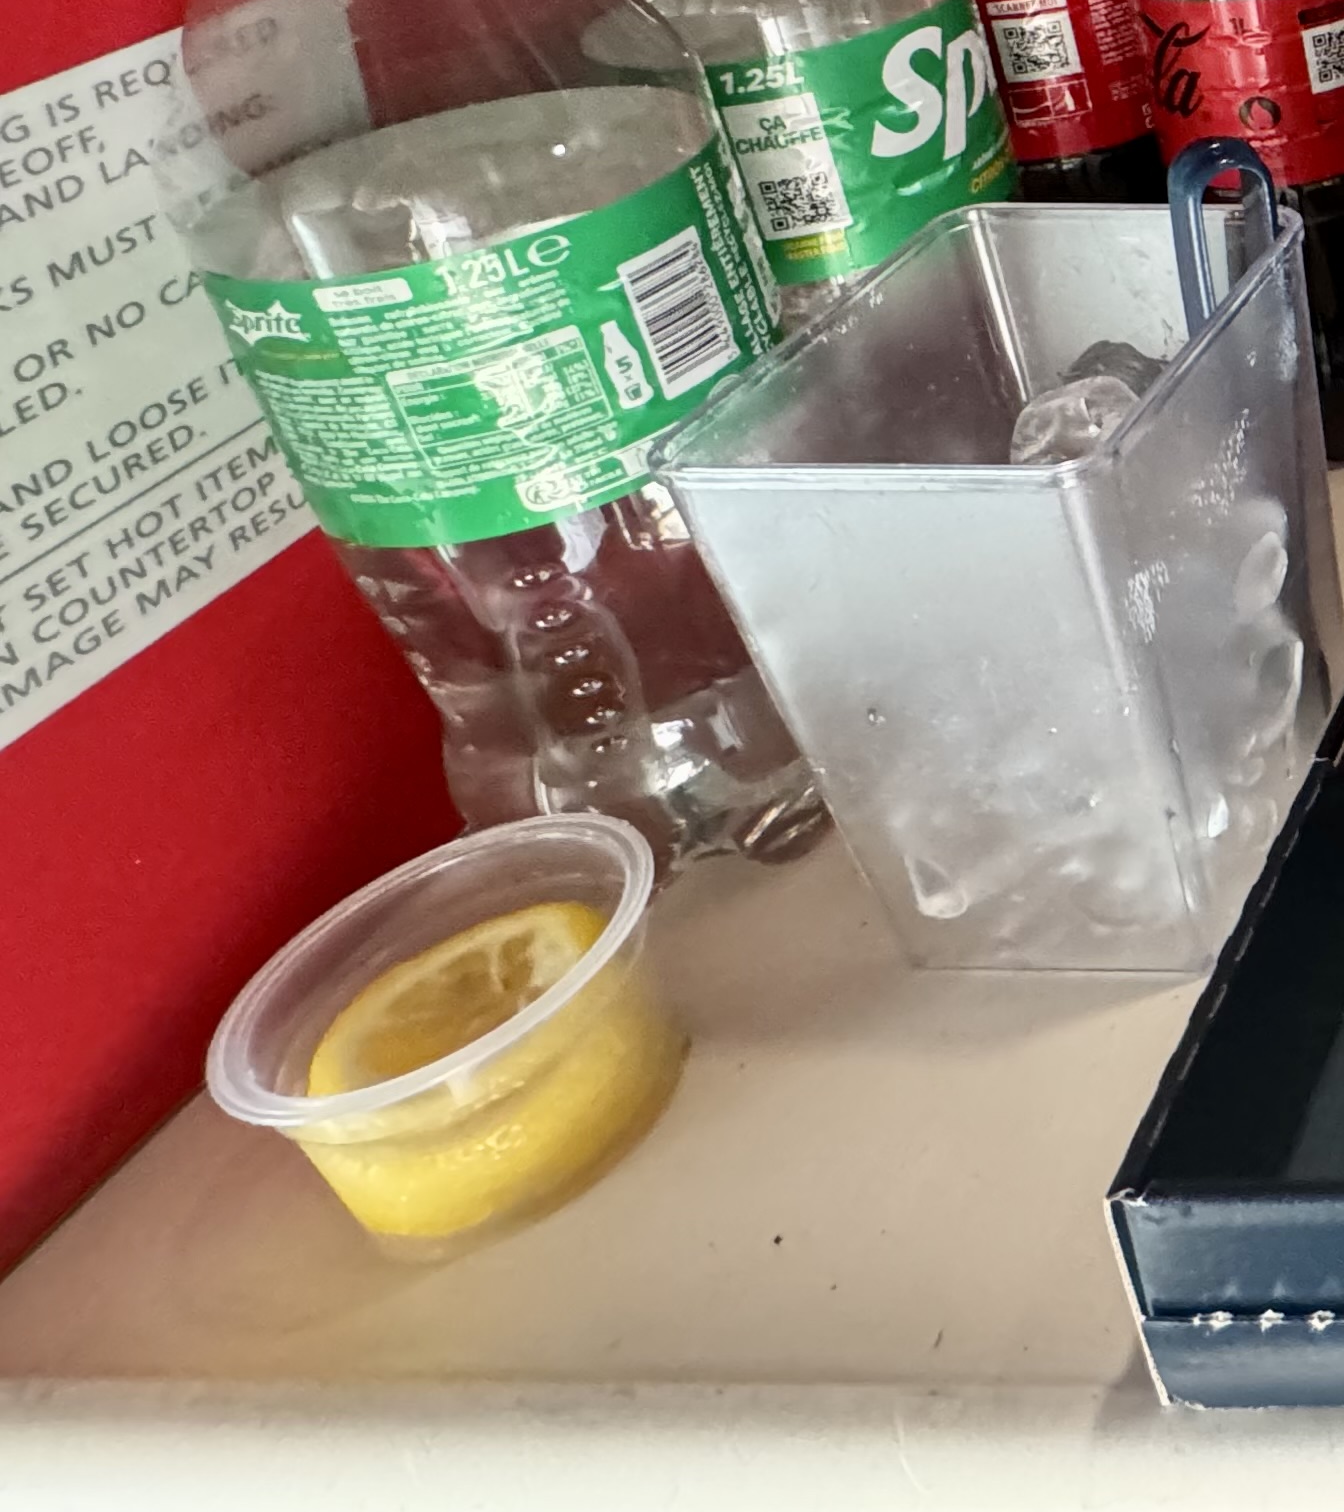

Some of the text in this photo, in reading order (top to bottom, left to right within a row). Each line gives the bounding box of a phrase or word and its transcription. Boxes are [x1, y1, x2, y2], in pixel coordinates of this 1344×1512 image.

[44, 93, 82, 128] IS
[719, 62, 805, 96] 1.25L
[871, 24, 998, 159] Sp
[735, 127, 824, 155] CHAUFFE
[758, 114, 787, 135] ÇA
[46, 214, 157, 289] MUST
[13, 338, 75, 383] OR
[86, 301, 146, 348] NO
[86, 377, 209, 463] LOOSE
[20, 424, 208, 541] SECURED.
[23, 436, 280, 613] SET HOT ITEM
[32, 471, 276, 644] COUNTERTOP
[136, 544, 215, 616] MAY
[229, 491, 308, 552] RESU
